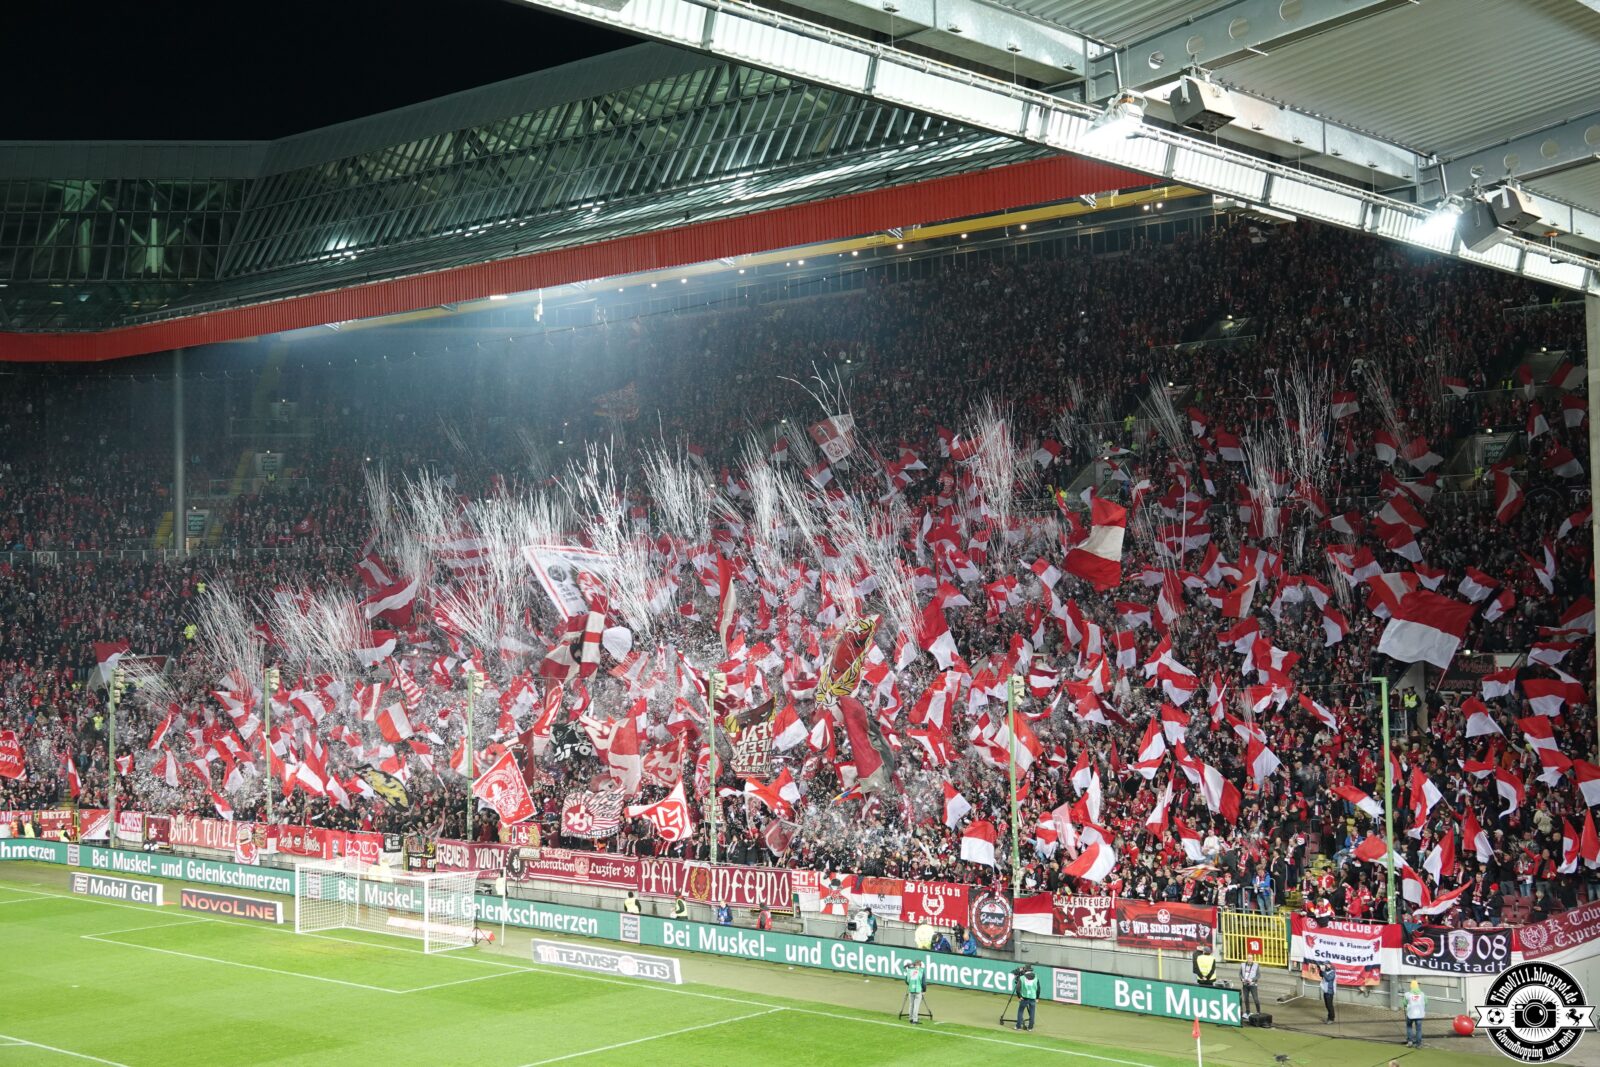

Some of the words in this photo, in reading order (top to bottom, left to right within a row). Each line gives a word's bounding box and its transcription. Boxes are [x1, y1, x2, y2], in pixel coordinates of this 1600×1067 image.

[41, 810, 71, 820] BETZE
[92, 849, 109, 868] Bei
[112, 852, 157, 873] Muskel-
[160, 859, 182, 878] und
[187, 861, 290, 893] Gelenkschmerzen
[589, 863, 622, 878] Luzifer
[90, 878, 127, 899] Mobil
[131, 885, 153, 903] Gel
[641, 860, 690, 898] PFALZ
[711, 867, 789, 907] INFERNO
[904, 881, 961, 898] Division
[338, 880, 359, 901] Bei
[365, 884, 422, 909] Muskel-
[429, 896, 455, 914] und
[461, 896, 598, 935] Gelenkschmerzen
[1132, 920, 1149, 935] WIR
[1150, 923, 1170, 934] SIND
[1171, 923, 1197, 938] BETZE
[1326, 920, 1372, 934] ANCLUB
[1319, 938, 1337, 947] Feuer
[1475, 935, 1508, 961] 08
[664, 922, 691, 947] Bei
[699, 928, 777, 958] Muskel-
[785, 941, 822, 963] und
[831, 942, 1015, 991] Gelenkshmerzen
[1406, 954, 1506, 974] Grünstadt
[1114, 979, 1152, 1010] Bei
[1165, 986, 1241, 1023] Musk
